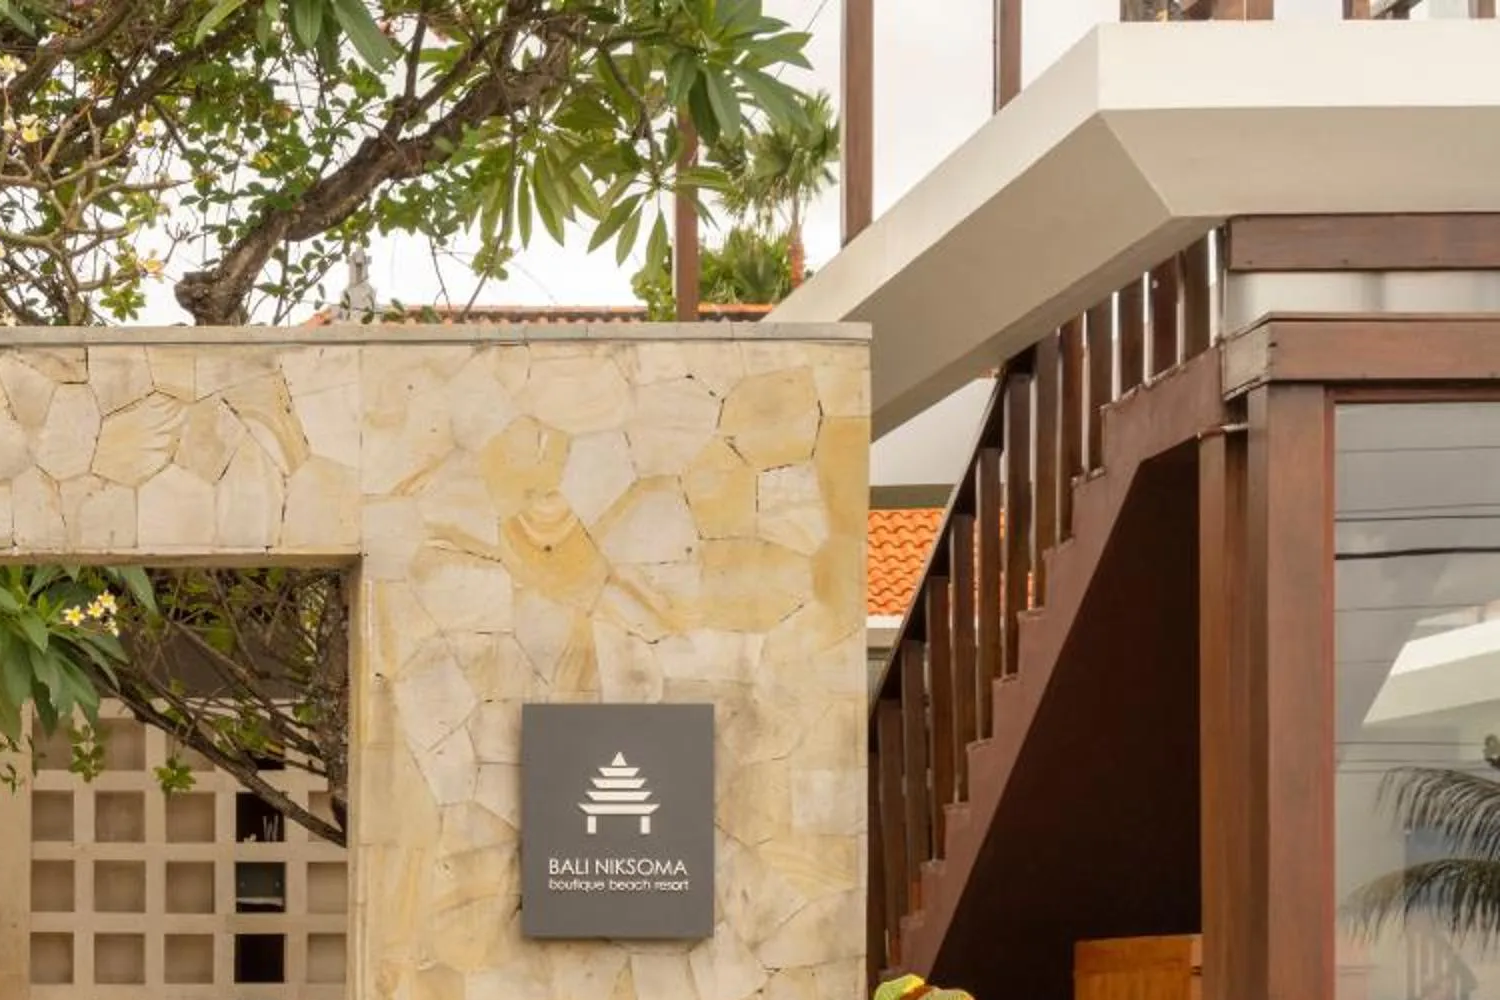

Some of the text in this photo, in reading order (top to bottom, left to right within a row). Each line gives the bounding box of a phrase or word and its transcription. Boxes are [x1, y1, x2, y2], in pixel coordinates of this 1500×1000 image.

[549, 858, 688, 876] BALI NIKSOMA
[549, 879, 688, 891] boutique beach resort
